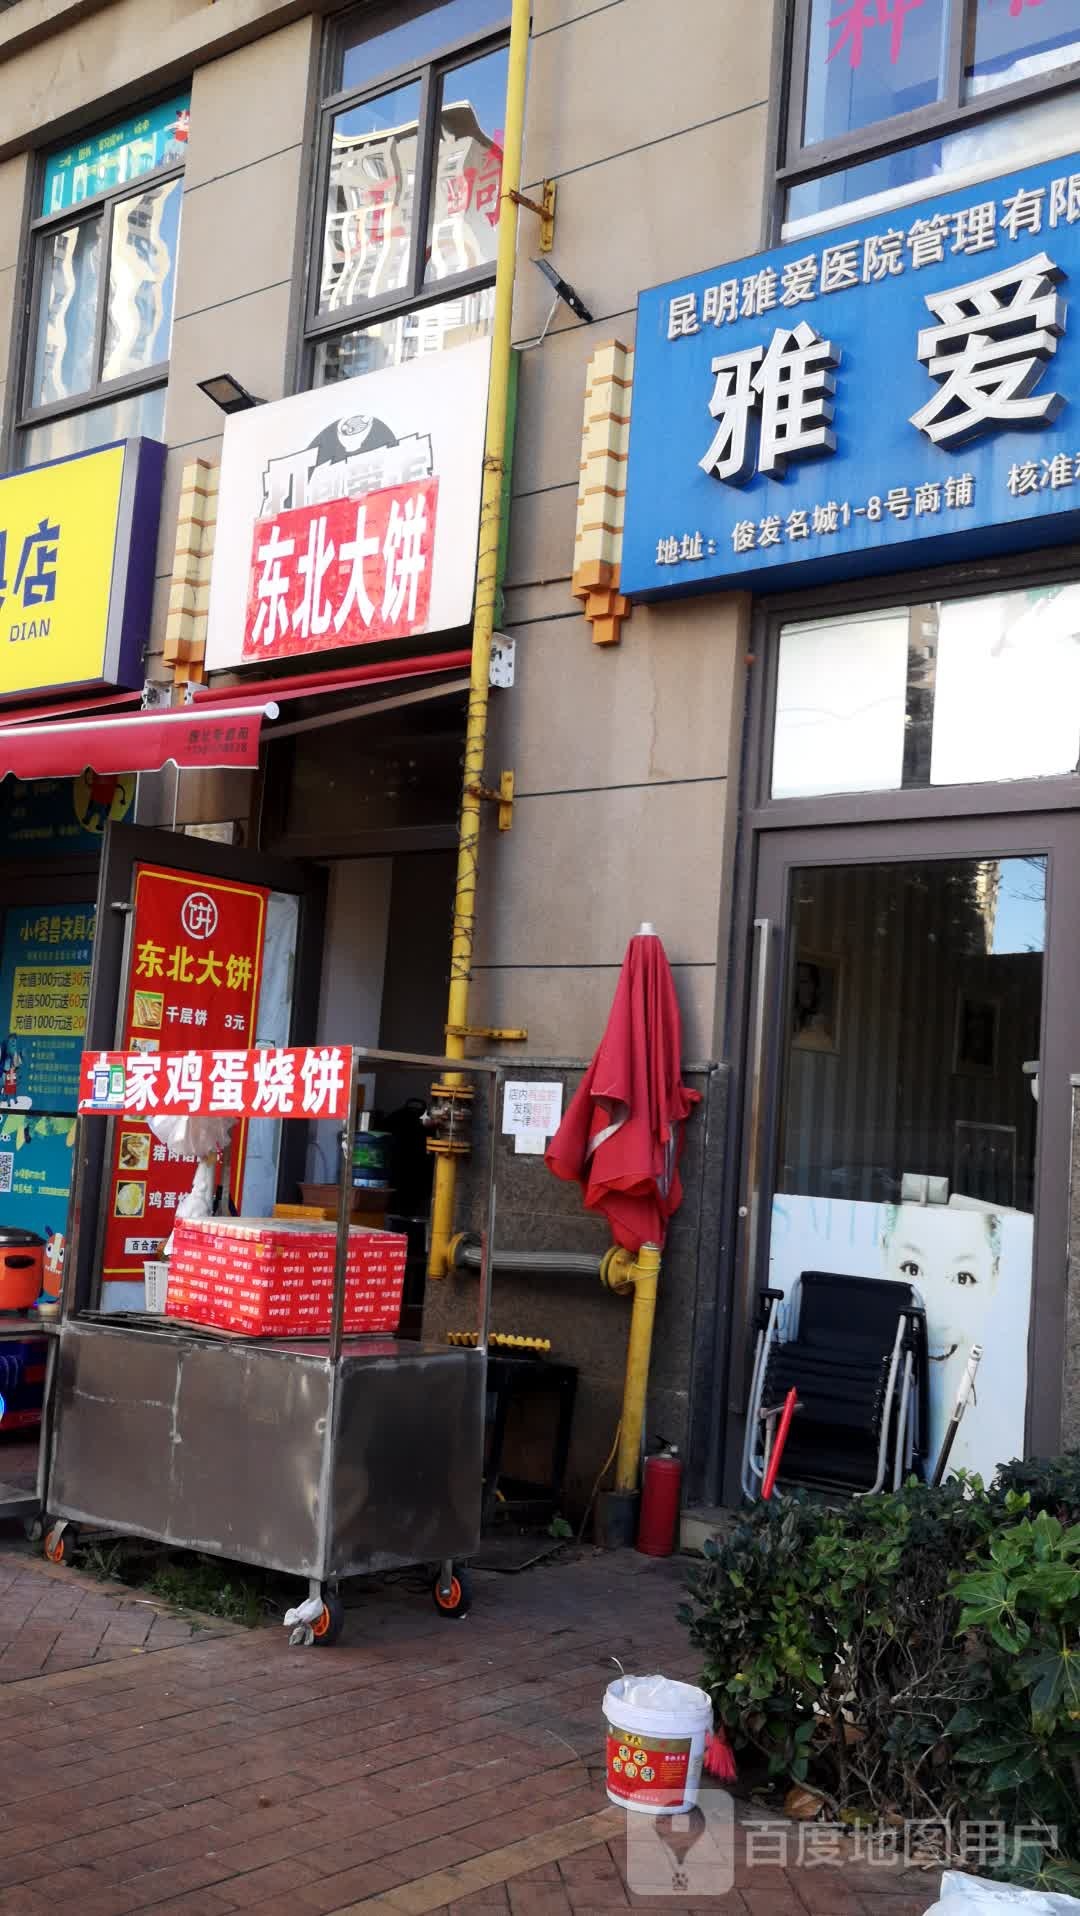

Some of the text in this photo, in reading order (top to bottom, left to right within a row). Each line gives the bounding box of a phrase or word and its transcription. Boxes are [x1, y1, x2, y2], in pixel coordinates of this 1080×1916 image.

[667, 173, 1080, 341] 昆明雅爱医院管理有限
[1007, 452, 1080, 496] 核准
[0, 518, 61, 612] 店
[251, 493, 427, 647] 东北大饼
[9, 618, 51, 643] DIAN
[135, 940, 252, 991] 东北大饼
[14, 1015, 87, 1031] 充值1000元送20
[166, 1006, 245, 1031] 千层饼 3元
